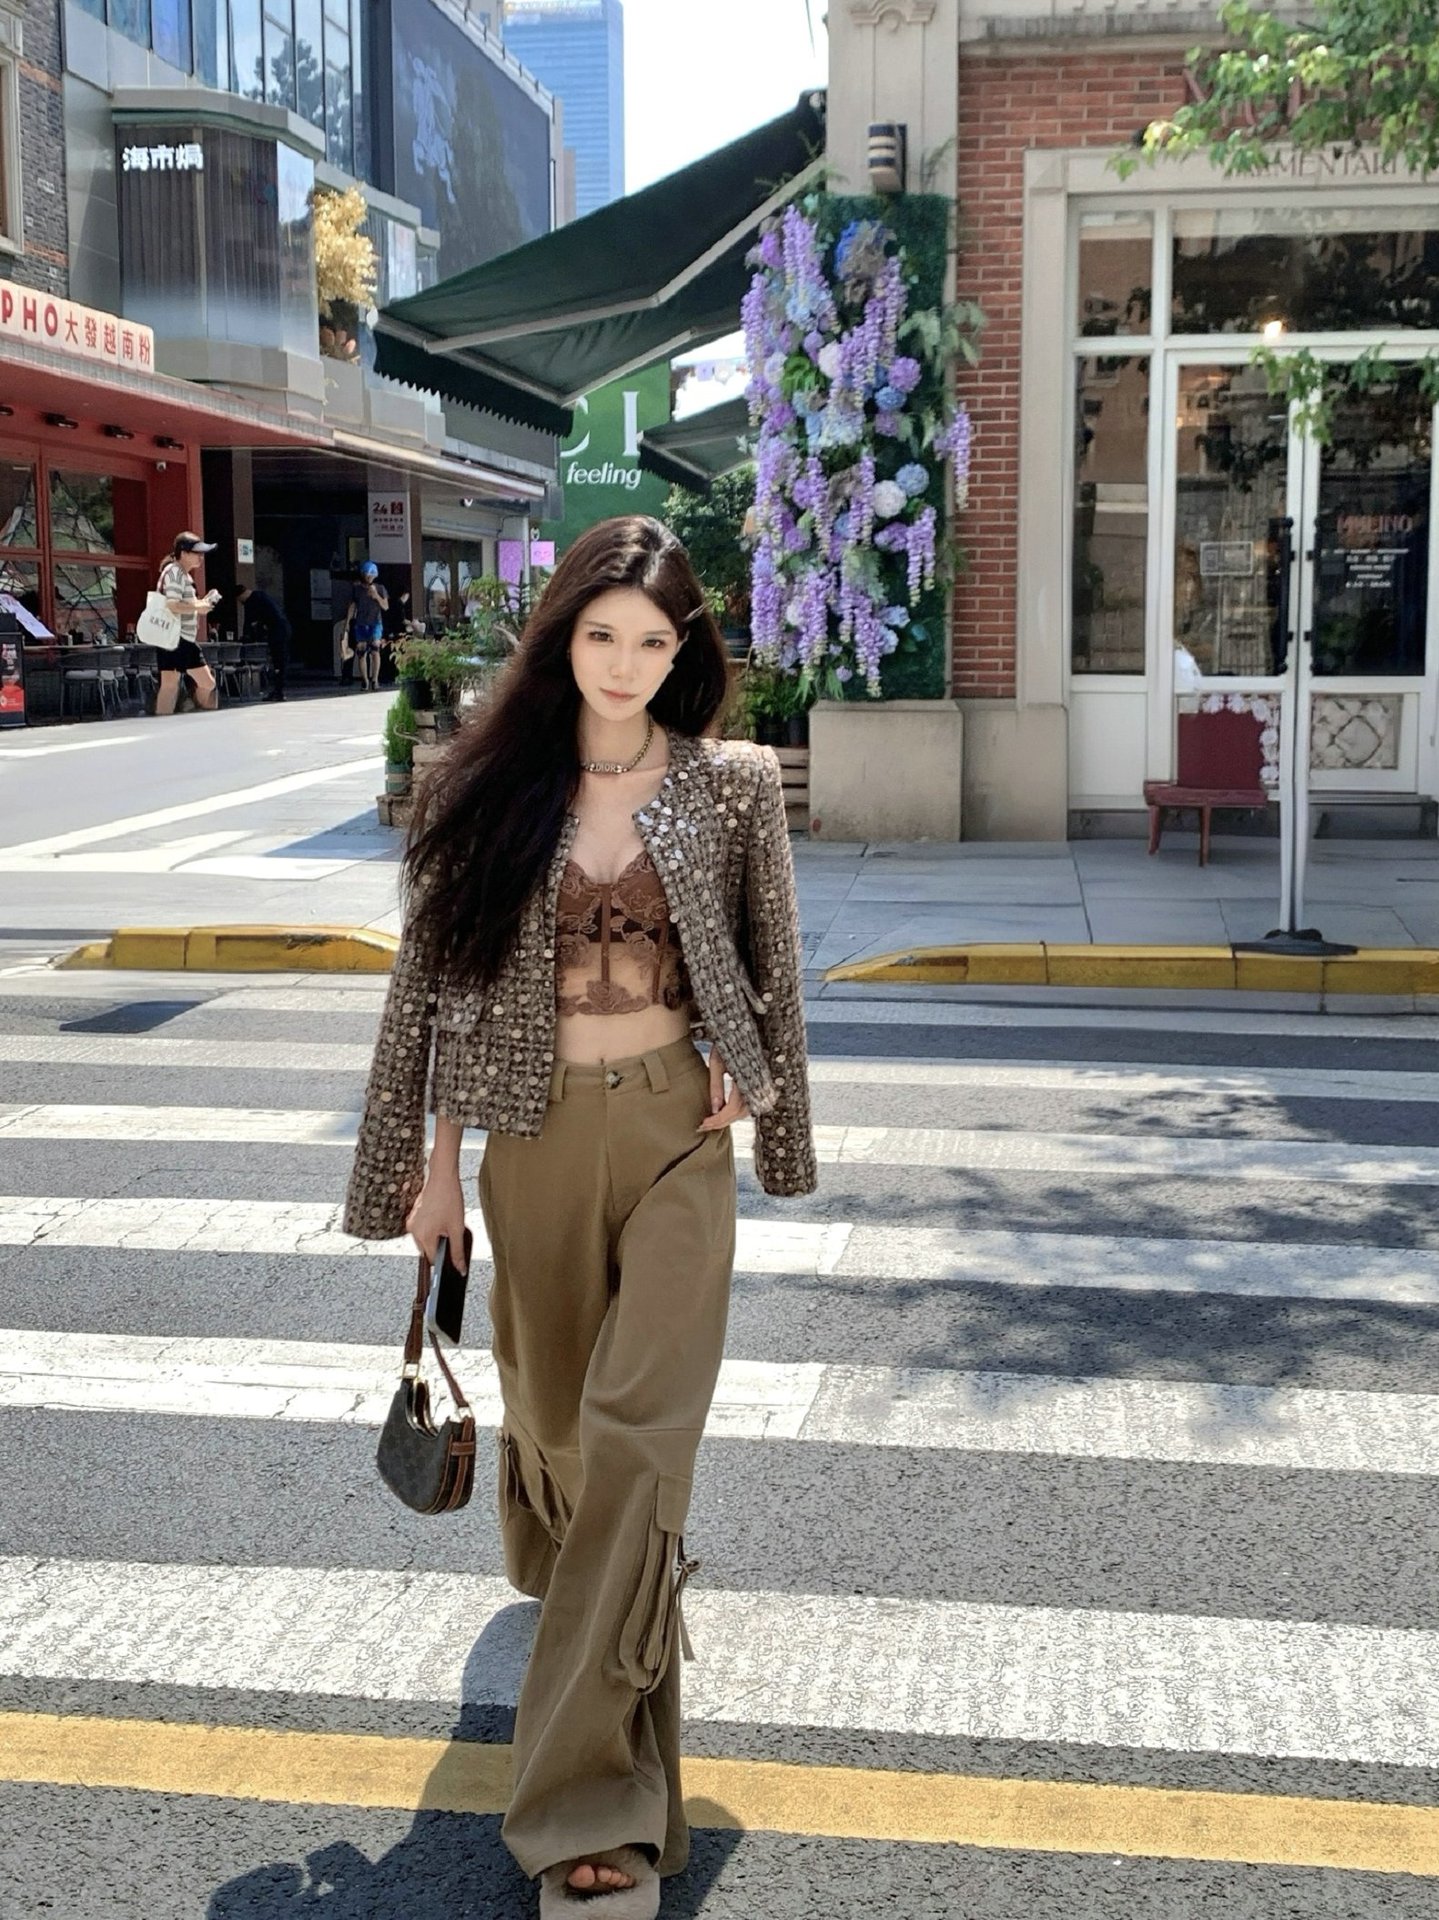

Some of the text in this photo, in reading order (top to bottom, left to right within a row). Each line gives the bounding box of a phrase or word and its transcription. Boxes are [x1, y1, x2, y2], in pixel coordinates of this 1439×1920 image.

[1, 289, 151, 365] PHO 大發越南粉
[566, 461, 642, 490] feeling
[595, 762, 616, 773] DIOR
